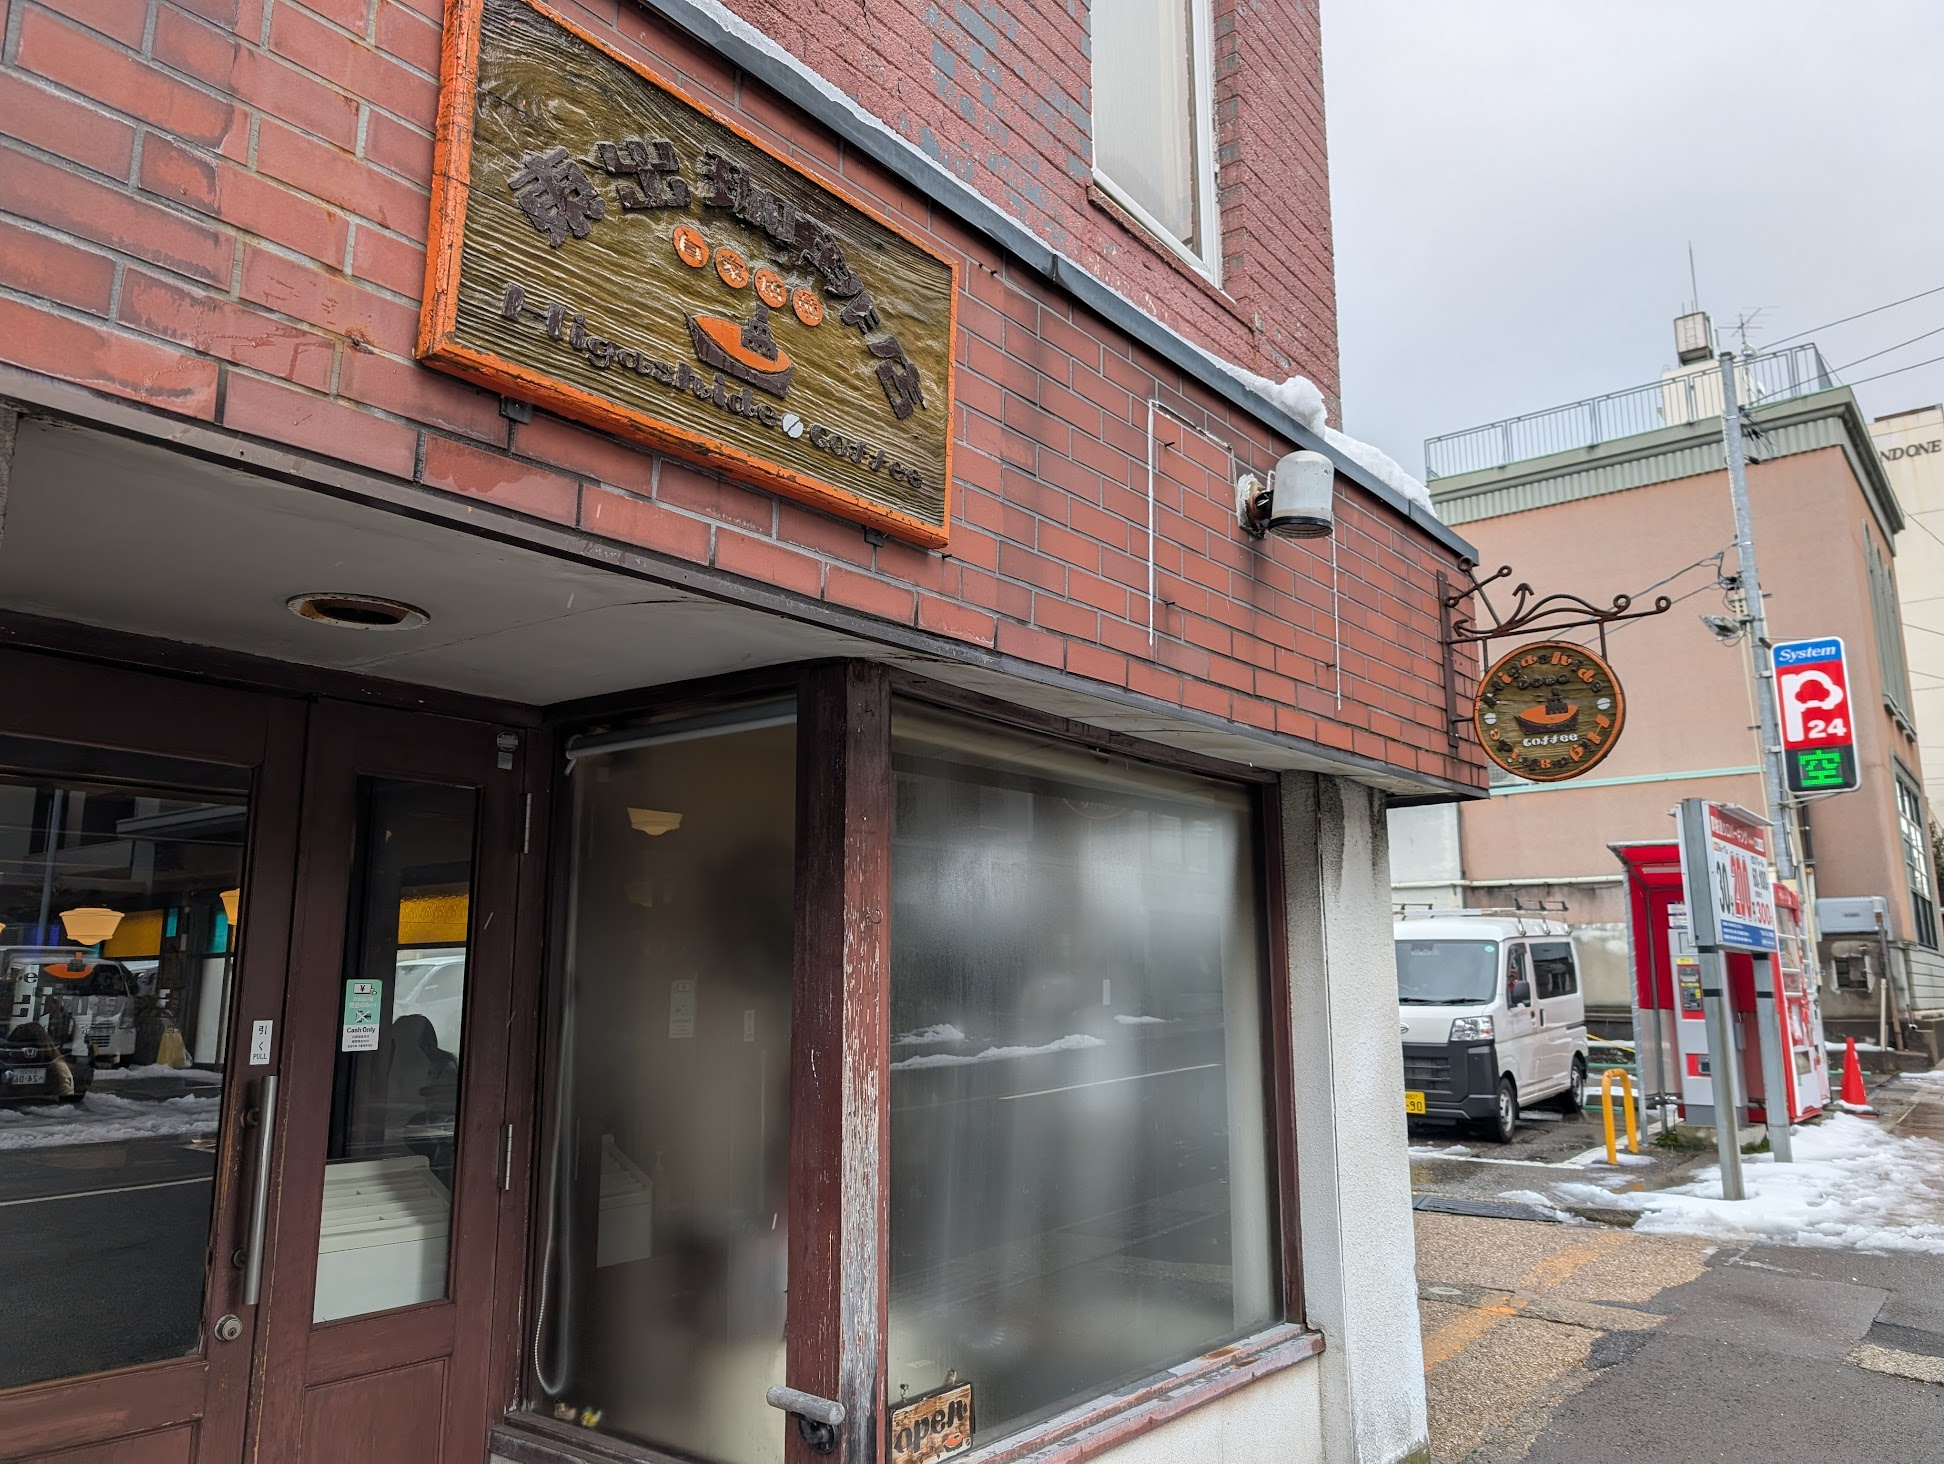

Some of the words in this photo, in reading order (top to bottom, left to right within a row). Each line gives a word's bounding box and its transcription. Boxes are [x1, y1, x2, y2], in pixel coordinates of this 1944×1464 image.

[501, 282, 779, 428] Higashide
[808, 422, 923, 488] coffee
[1779, 645, 1836, 662] System
[1807, 718, 1847, 739] 24
[1522, 733, 1578, 747] coffee
[1798, 749, 1845, 787] 空
[363, 1026, 376, 1034] Only
[893, 1399, 968, 1454] open
